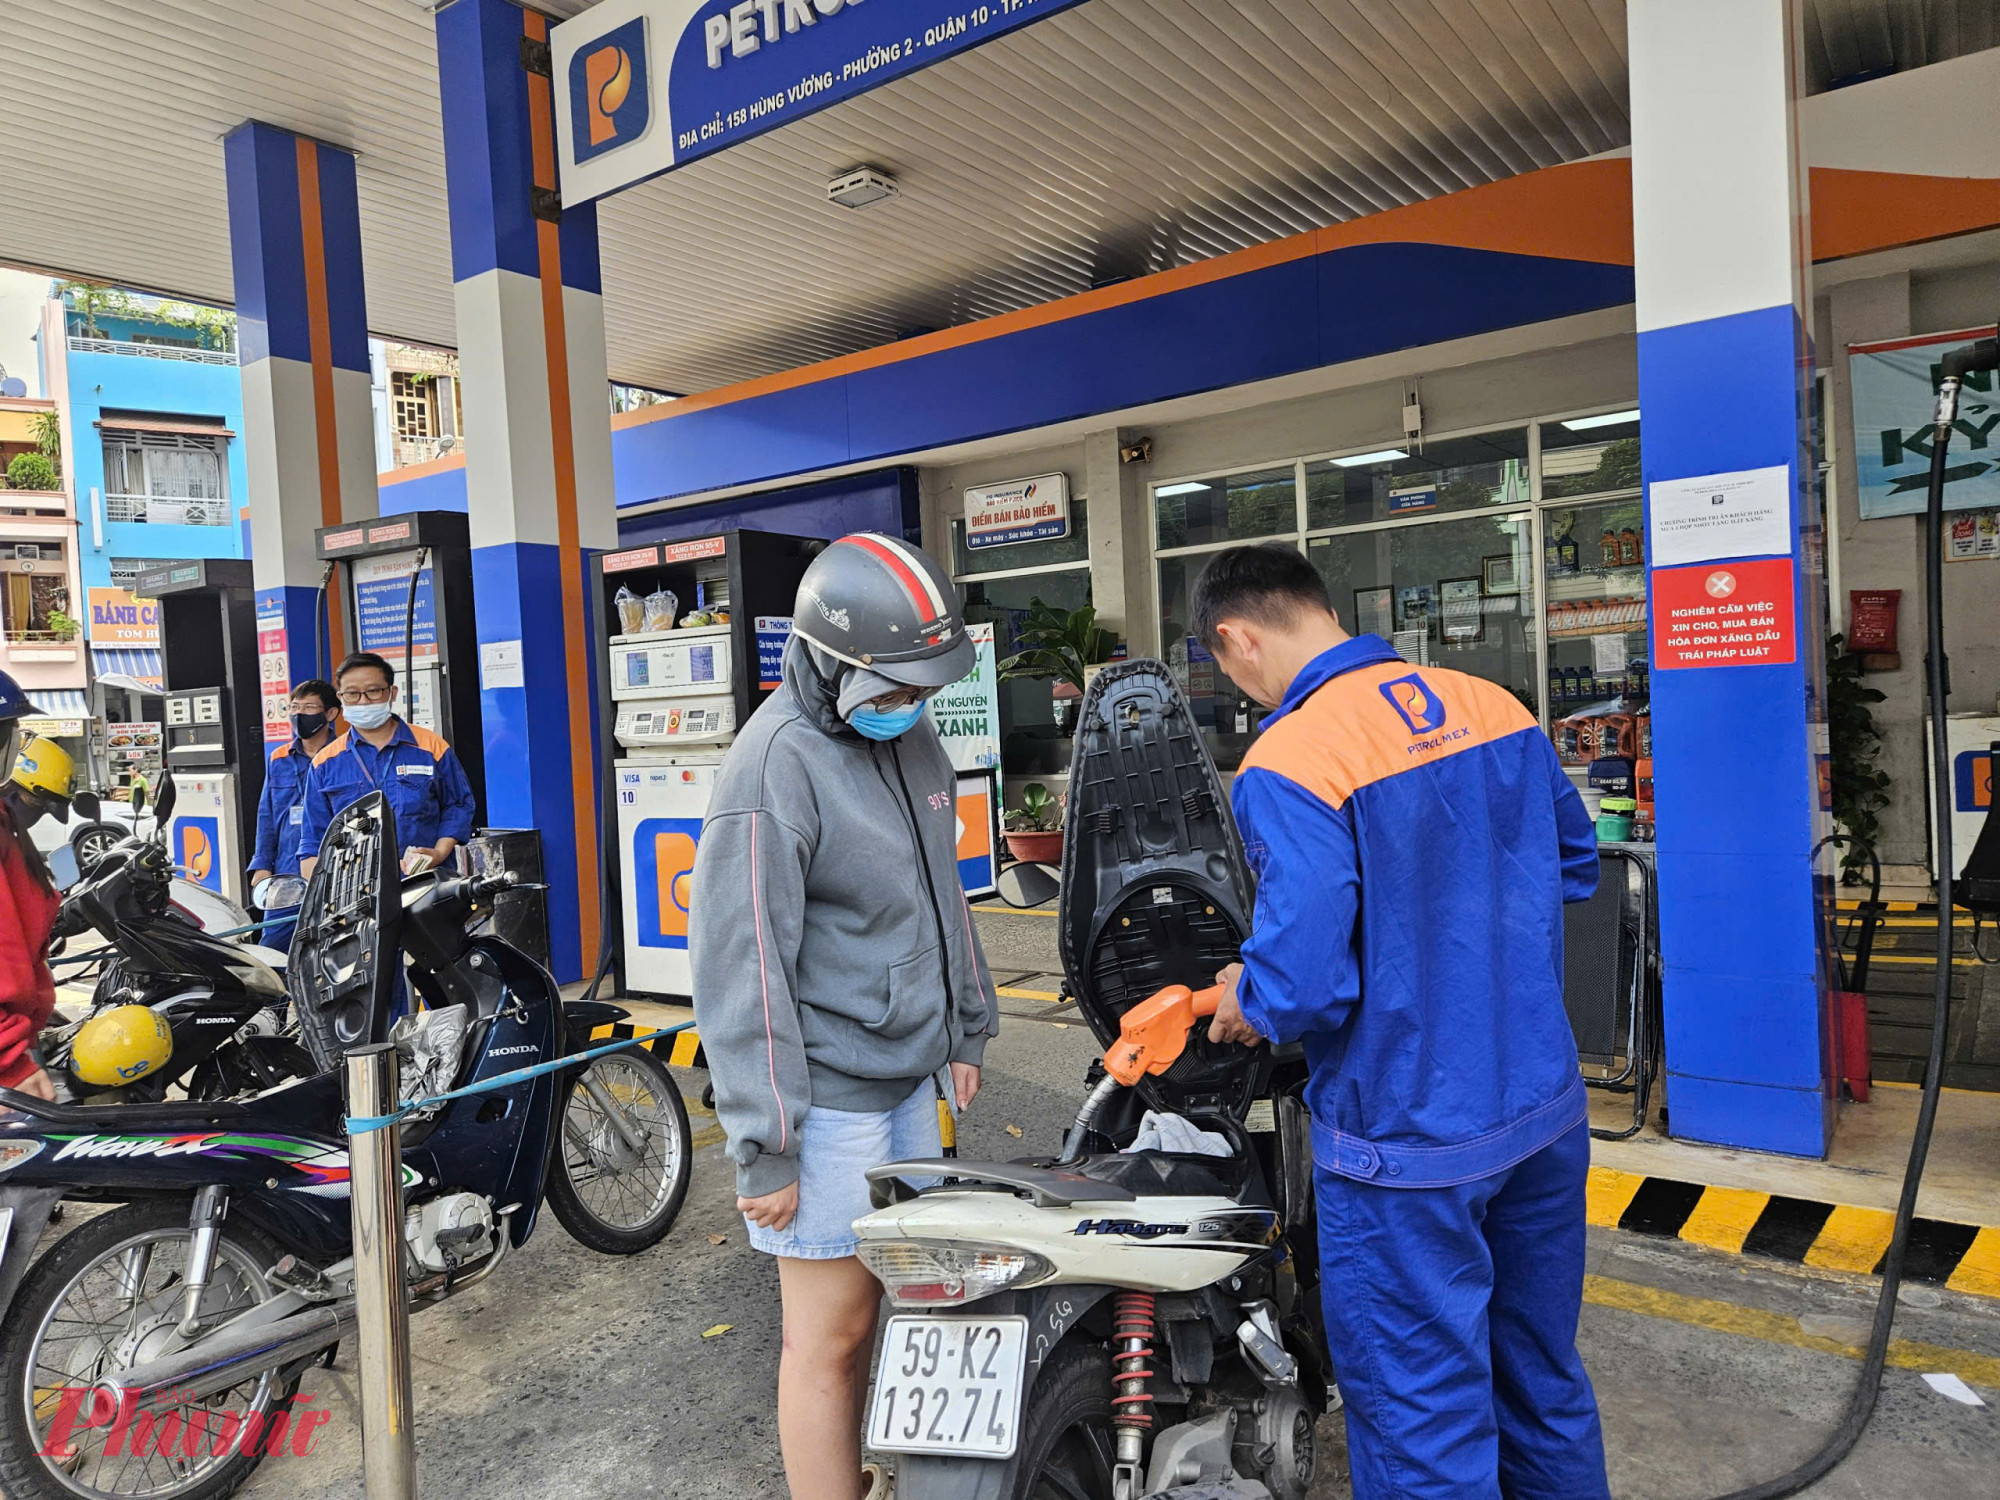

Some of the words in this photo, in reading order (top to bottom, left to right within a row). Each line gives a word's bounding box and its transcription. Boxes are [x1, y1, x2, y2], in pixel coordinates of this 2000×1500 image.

[679, 129, 698, 149] ĐỊA
[700, 111, 724, 140] CHỈ:
[726, 108, 747, 129] 158
[750, 93, 785, 120] HÙNG
[787, 71, 833, 103] VƯƠNG
[843, 45, 901, 81] PHƯỜNG
[904, 38, 913, 56] 2
[924, 16, 967, 47] QUẬN
[970, 6, 988, 27] 10
[972, 510, 992, 527] ĐIỂM
[994, 510, 1011, 523] BÁN
[1014, 505, 1031, 520] BẢO
[1033, 501, 1056, 517] HIỂM
[671, 544, 688, 554] XĂNG
[690, 543, 704, 551] RON
[705, 540, 719, 549] 95-V
[93, 600, 138, 625] BÁNH
[141, 606, 159, 625] CA
[1671, 606, 1715, 617] NGHIÊM
[1718, 604, 1743, 614] CẤM
[1746, 601, 1774, 613] VIỆC
[1672, 623, 1690, 632] XIN
[1693, 622, 1720, 631] CHO,
[1722, 619, 1747, 628] MUA
[1750, 616, 1774, 626] BÁN
[116, 627, 142, 638] TÔM
[1668, 637, 1691, 647] HÓA
[1694, 634, 1717, 645] ĐƠN
[1720, 632, 1753, 643] XĂNG
[1756, 630, 1780, 641] DẦU
[1678, 650, 1703, 660] TRÁI
[1706, 647, 1736, 658] PHÁP
[1739, 645, 1769, 657] LUẬT
[933, 694, 945, 708] KỶ
[947, 694, 988, 707] NGUYÊN
[936, 718, 988, 737] XANH
[624, 775, 640, 783] VISA
[622, 791, 634, 803] 10
[196, 1017, 236, 1025] HONDA
[488, 1044, 539, 1057] HONDA
[117, 1060, 150, 1079] be
[1199, 1221, 1221, 1232] 125
[902, 1326, 1002, 1379] 59-K2
[884, 1386, 1005, 1445] 132.74
